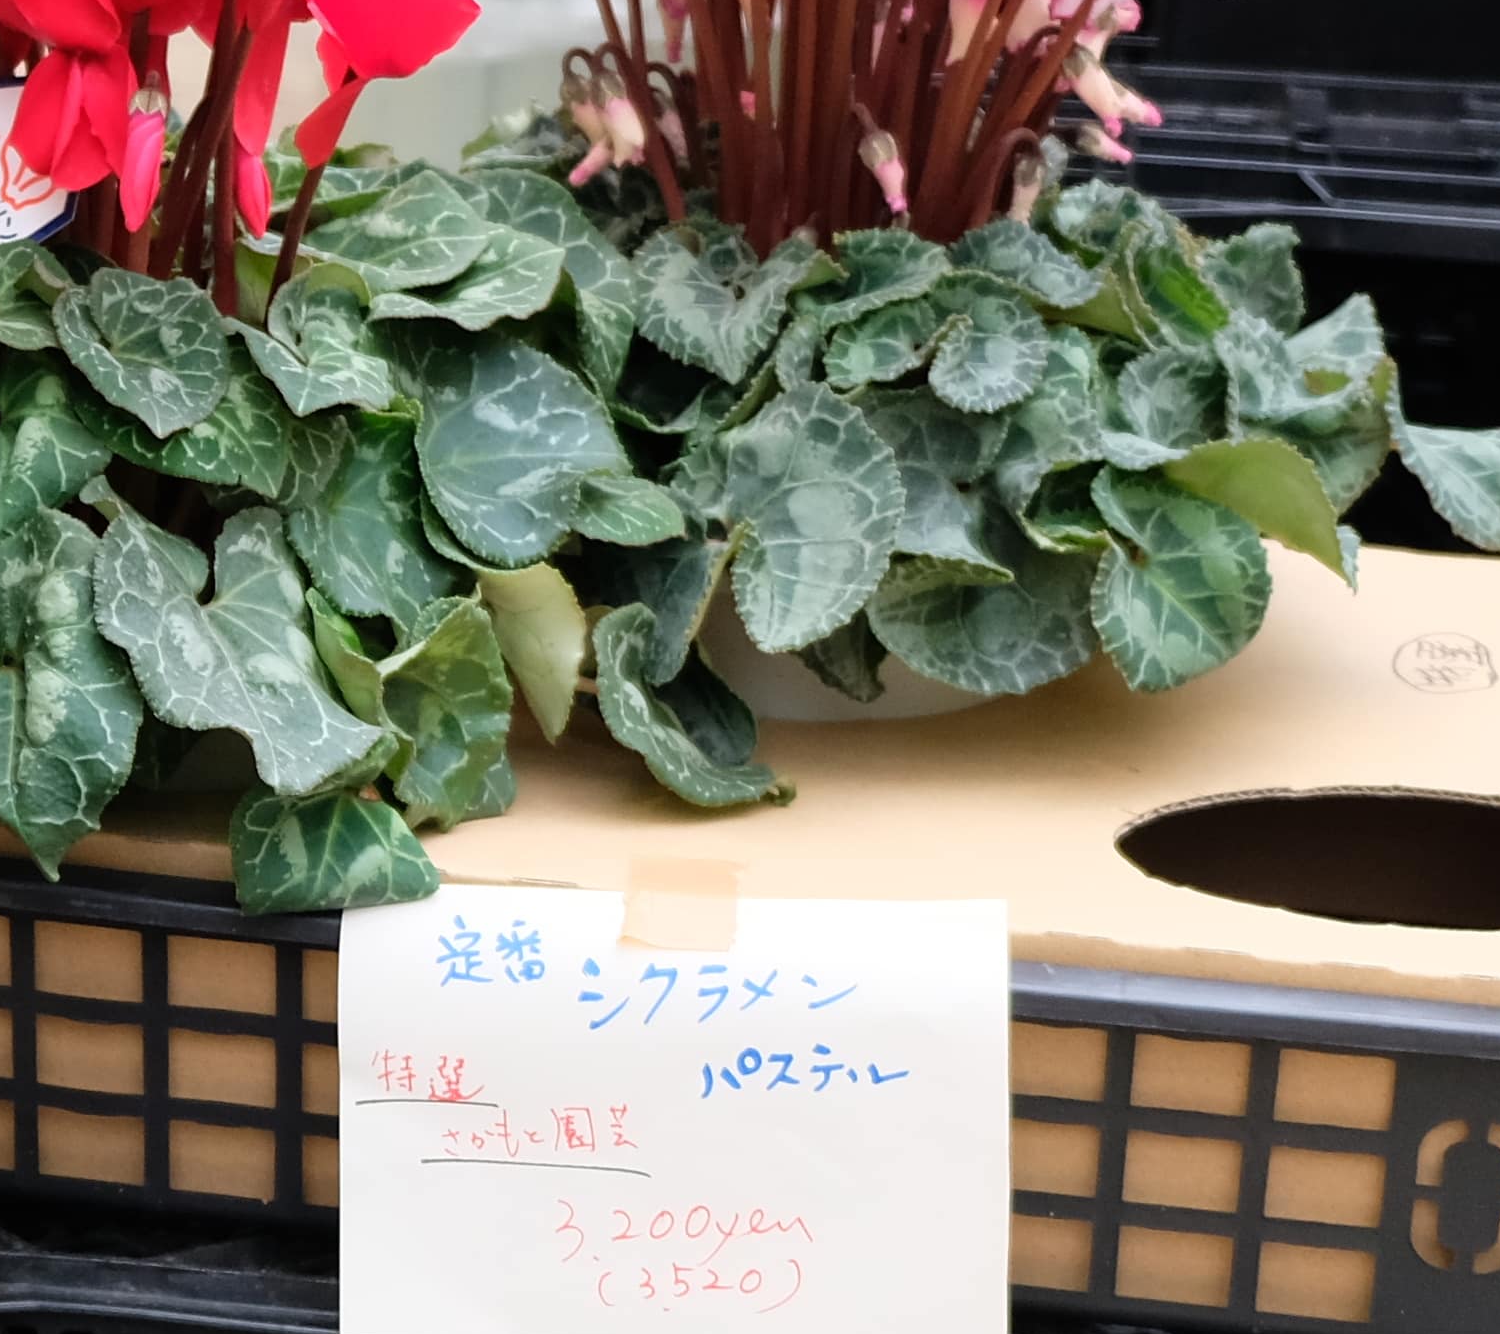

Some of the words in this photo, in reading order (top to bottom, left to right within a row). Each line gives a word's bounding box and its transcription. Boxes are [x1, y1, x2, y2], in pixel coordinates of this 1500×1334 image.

[435, 913, 546, 988] 定番
[577, 957, 858, 1030] シクラメン
[700, 1043, 912, 1099] パステル
